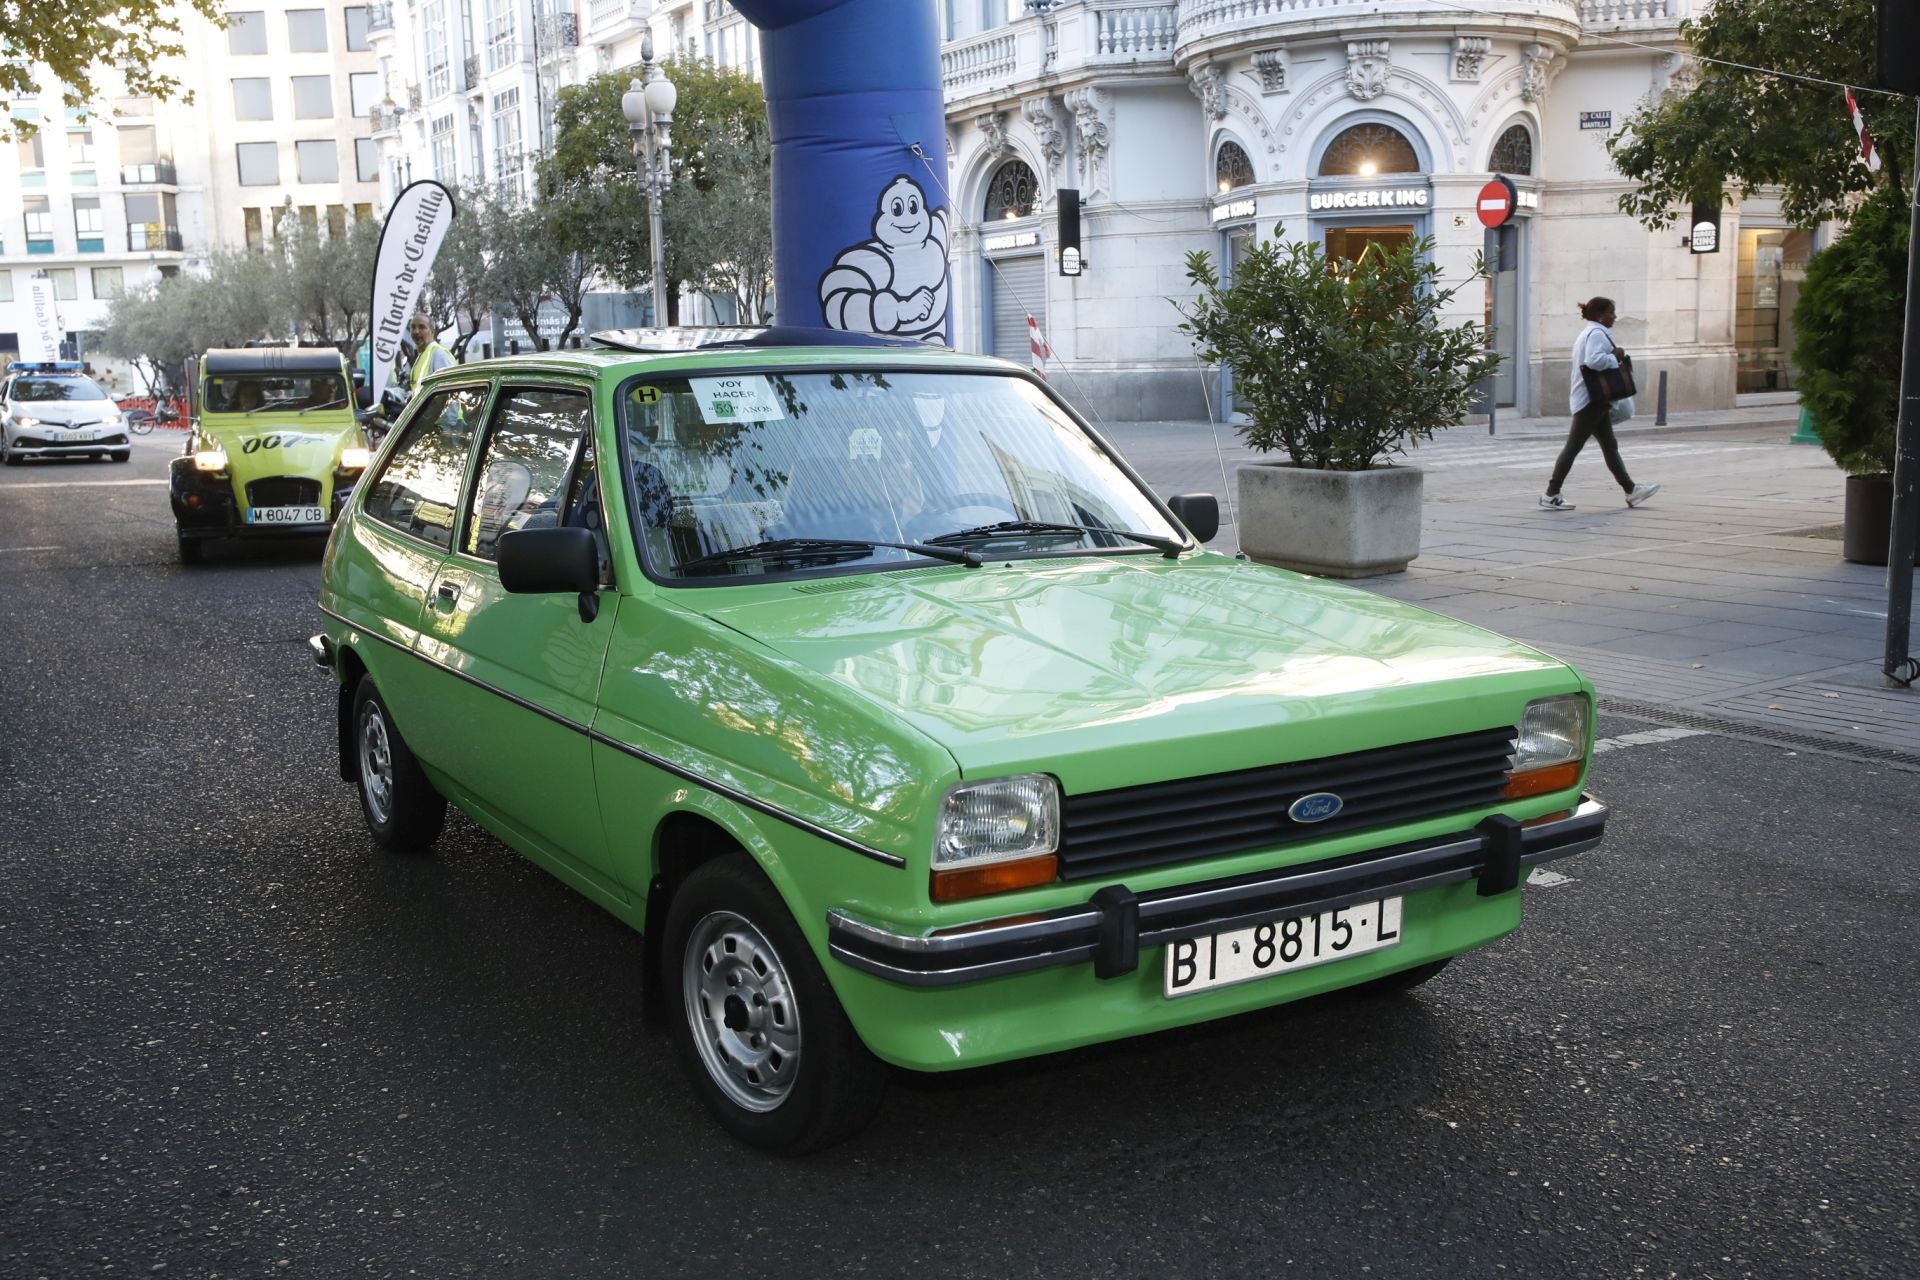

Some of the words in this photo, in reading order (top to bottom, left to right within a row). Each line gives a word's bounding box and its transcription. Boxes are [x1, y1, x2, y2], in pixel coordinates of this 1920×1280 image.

[1590, 111, 1611, 119] CALLE
[1311, 190, 1380, 210] BURGER
[1380, 189, 1428, 207] KING
[404, 190, 444, 262] Castilla
[1693, 237, 1716, 246] KING
[1063, 261, 1080, 269] KING
[395, 263, 417, 284] de
[379, 285, 410, 335] Norte
[540, 326, 585, 335] hablaos
[375, 337, 397, 363] El
[717, 380, 742, 388] VOY
[638, 389, 657, 402] H
[713, 390, 756, 399] HACER
[242, 435, 304, 454] 007
[305, 508, 322, 521] CB
[1302, 800, 1332, 817] Ford
